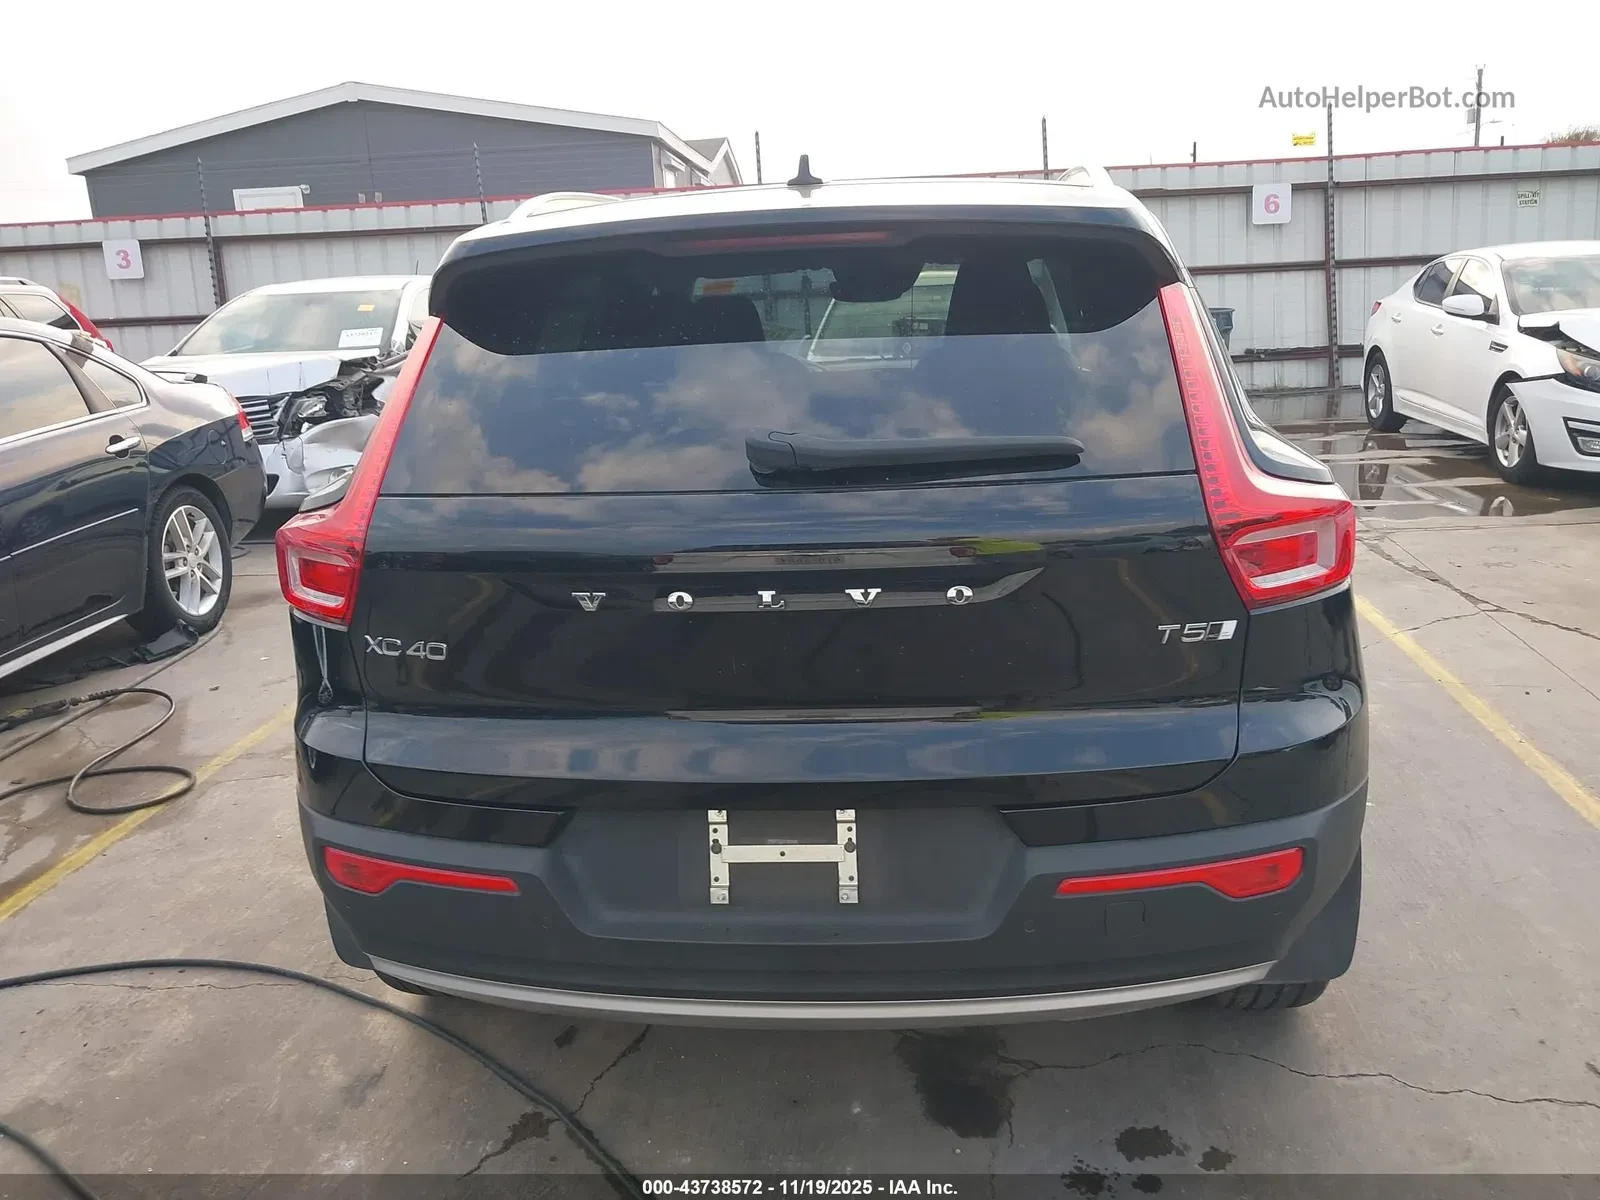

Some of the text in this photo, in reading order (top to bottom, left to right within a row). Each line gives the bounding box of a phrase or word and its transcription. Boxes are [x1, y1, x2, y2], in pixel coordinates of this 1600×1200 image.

[1264, 193, 1280, 214] 6
[115, 249, 131, 269] 3
[571, 585, 974, 612] VOLVO
[1157, 622, 1209, 645] T5
